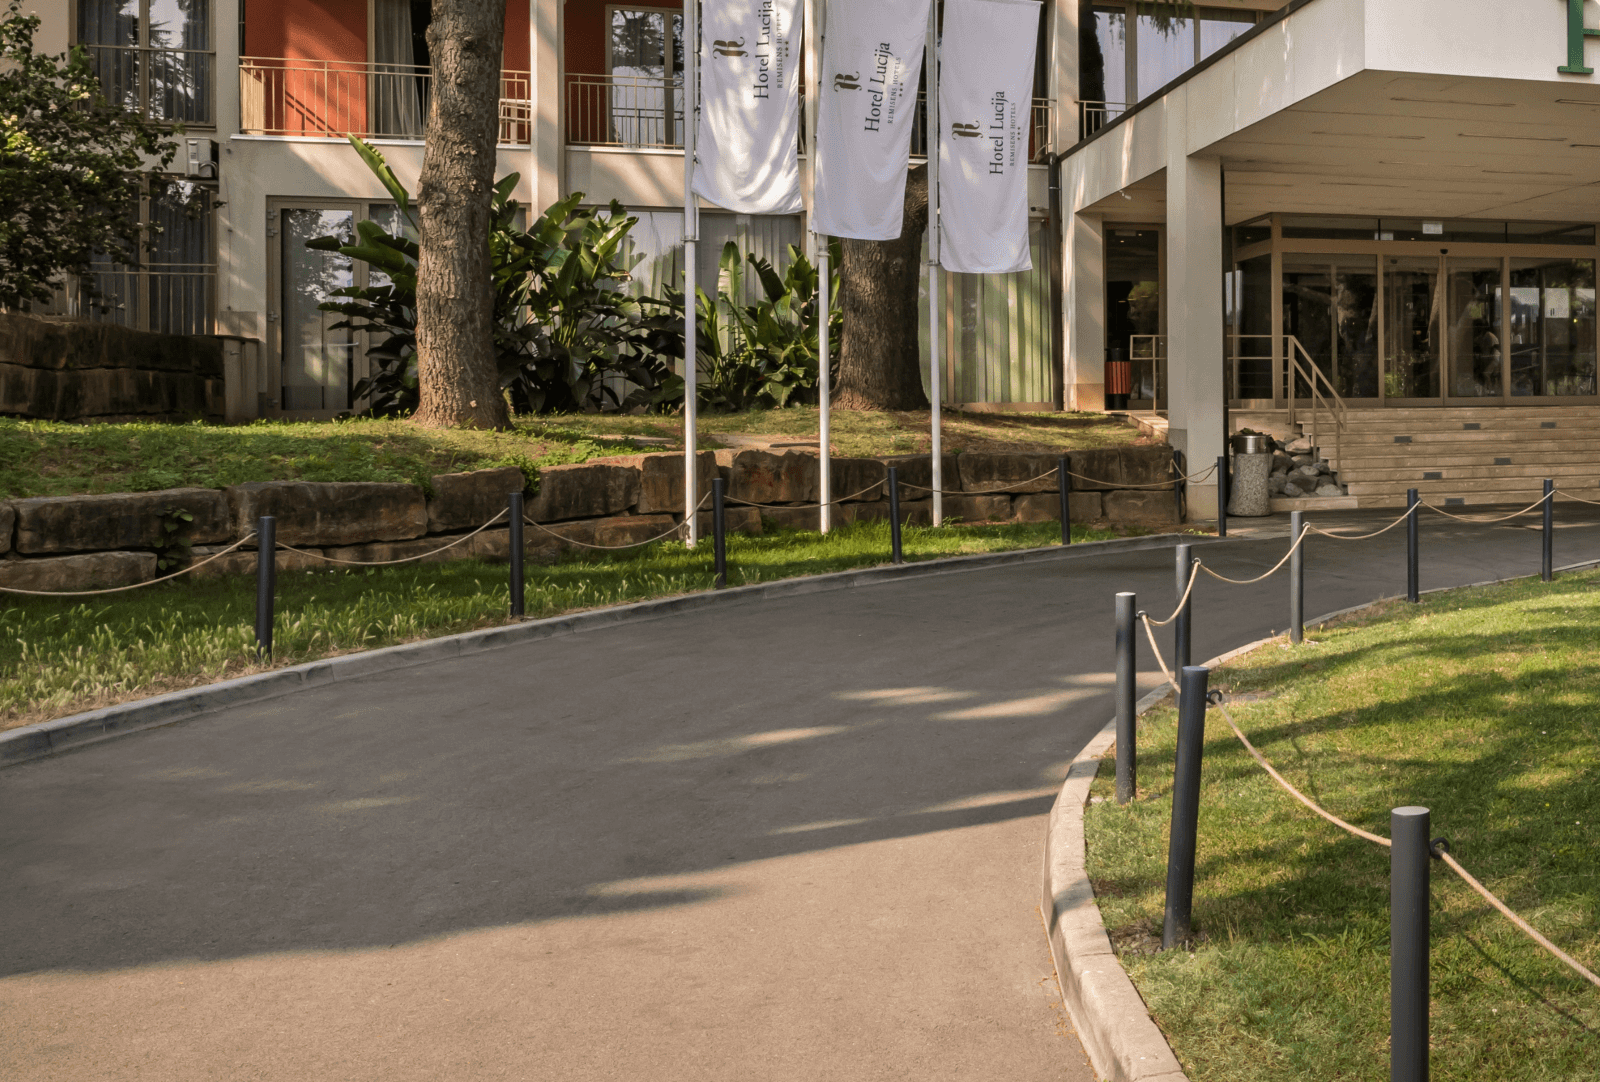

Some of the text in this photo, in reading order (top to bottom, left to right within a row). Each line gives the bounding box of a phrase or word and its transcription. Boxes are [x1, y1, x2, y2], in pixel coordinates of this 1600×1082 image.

[753, 0, 774, 99] Hotel Lucija
[864, 42, 893, 132] Hotel Lucija
[887, 56, 902, 124] REMISENS HOTELS
[989, 91, 1009, 175] Hotel Lucija
